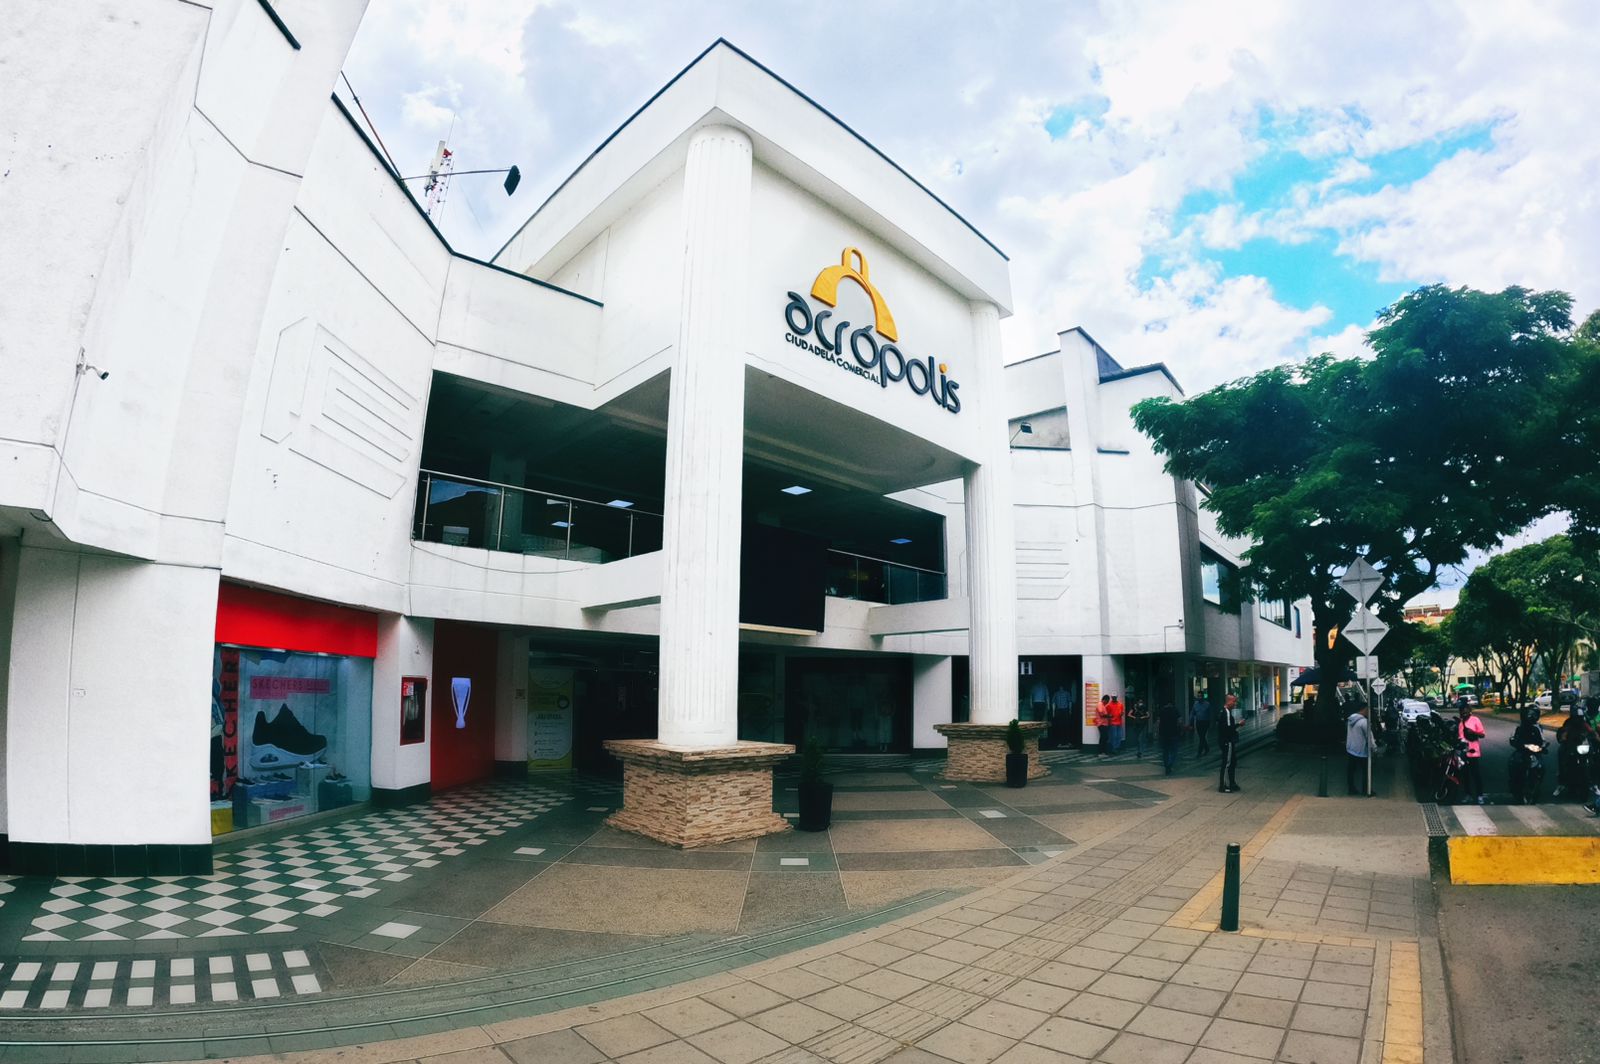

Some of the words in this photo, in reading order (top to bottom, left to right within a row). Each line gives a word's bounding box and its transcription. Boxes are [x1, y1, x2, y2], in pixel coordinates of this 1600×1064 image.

[785, 291, 961, 414] acrópolis
[785, 332, 836, 364] CIUDADELA
[836, 357, 881, 385] COMERCIAL
[223, 649, 239, 779] KECHER
[252, 678, 304, 691] SKECHERS
